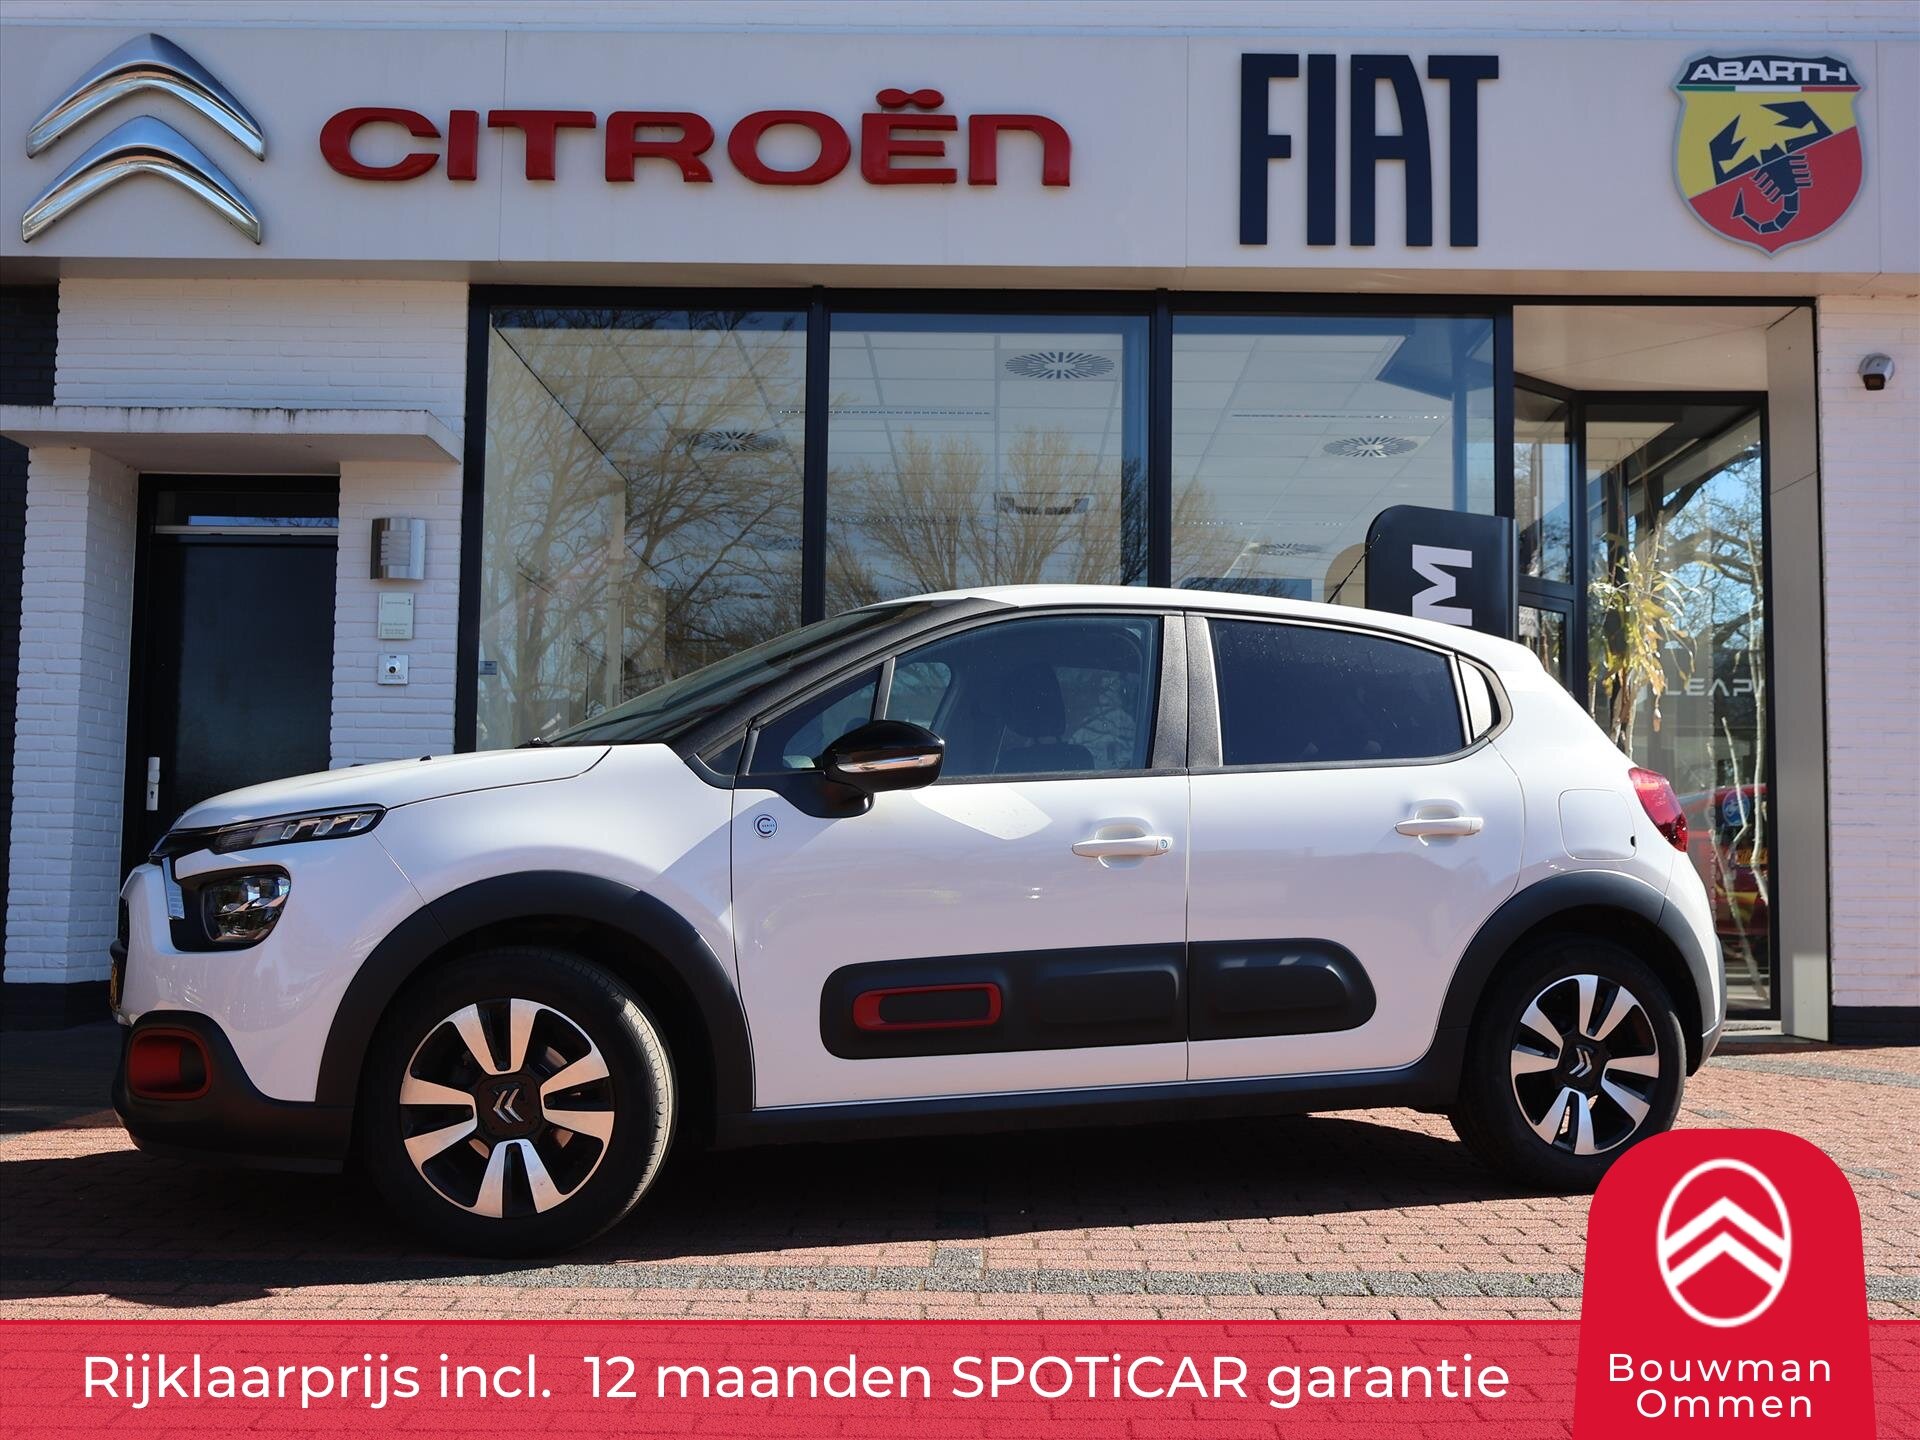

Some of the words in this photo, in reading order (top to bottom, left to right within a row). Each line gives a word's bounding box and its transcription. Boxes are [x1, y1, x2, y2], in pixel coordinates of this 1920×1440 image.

[1690, 59, 1847, 82] ABARTH
[321, 88, 1072, 188] CITROËN
[1240, 54, 1498, 247] FIAT
